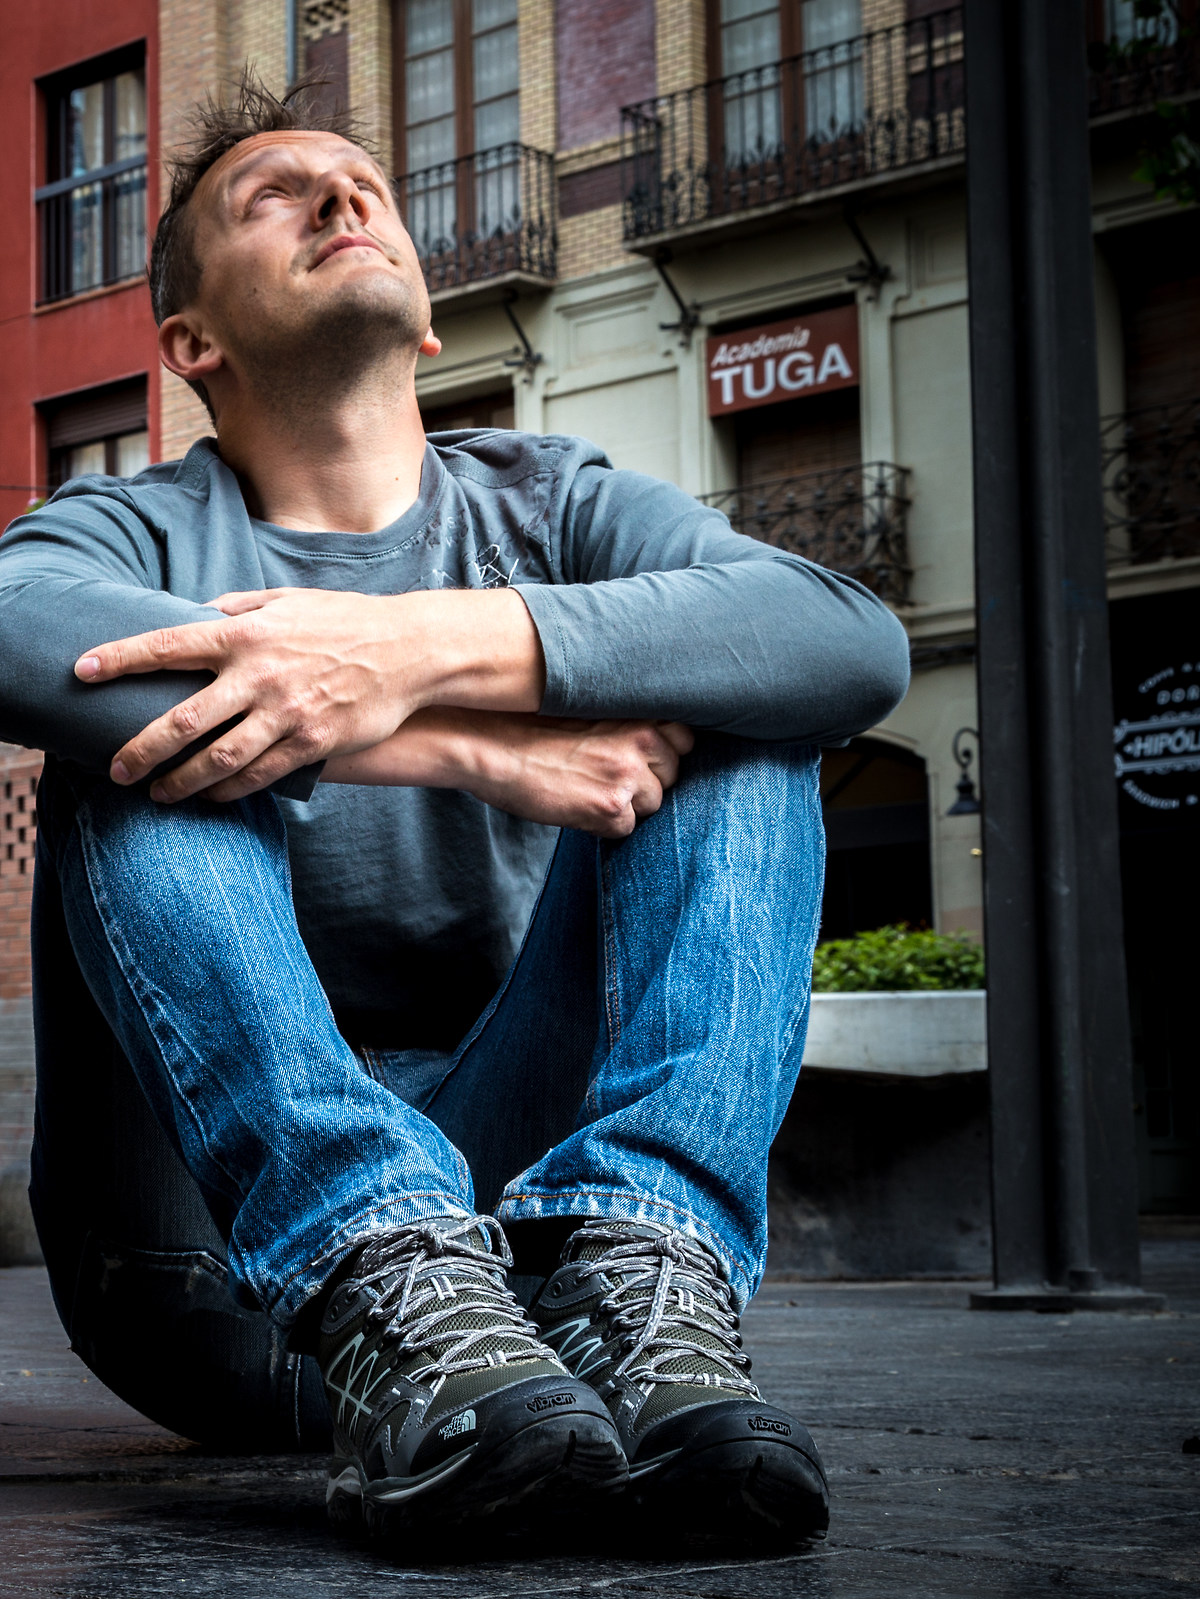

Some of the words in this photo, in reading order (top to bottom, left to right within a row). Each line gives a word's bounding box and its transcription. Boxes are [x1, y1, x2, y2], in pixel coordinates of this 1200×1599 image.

[711, 326, 810, 368] Academia
[711, 343, 852, 405] TUGA
[1133, 726, 1200, 757] HIPÓL
[525, 1392, 577, 1413] vibram
[438, 1417, 463, 1437] NORTH
[443, 1425, 462, 1441] FACE
[747, 1415, 792, 1437] vibram
